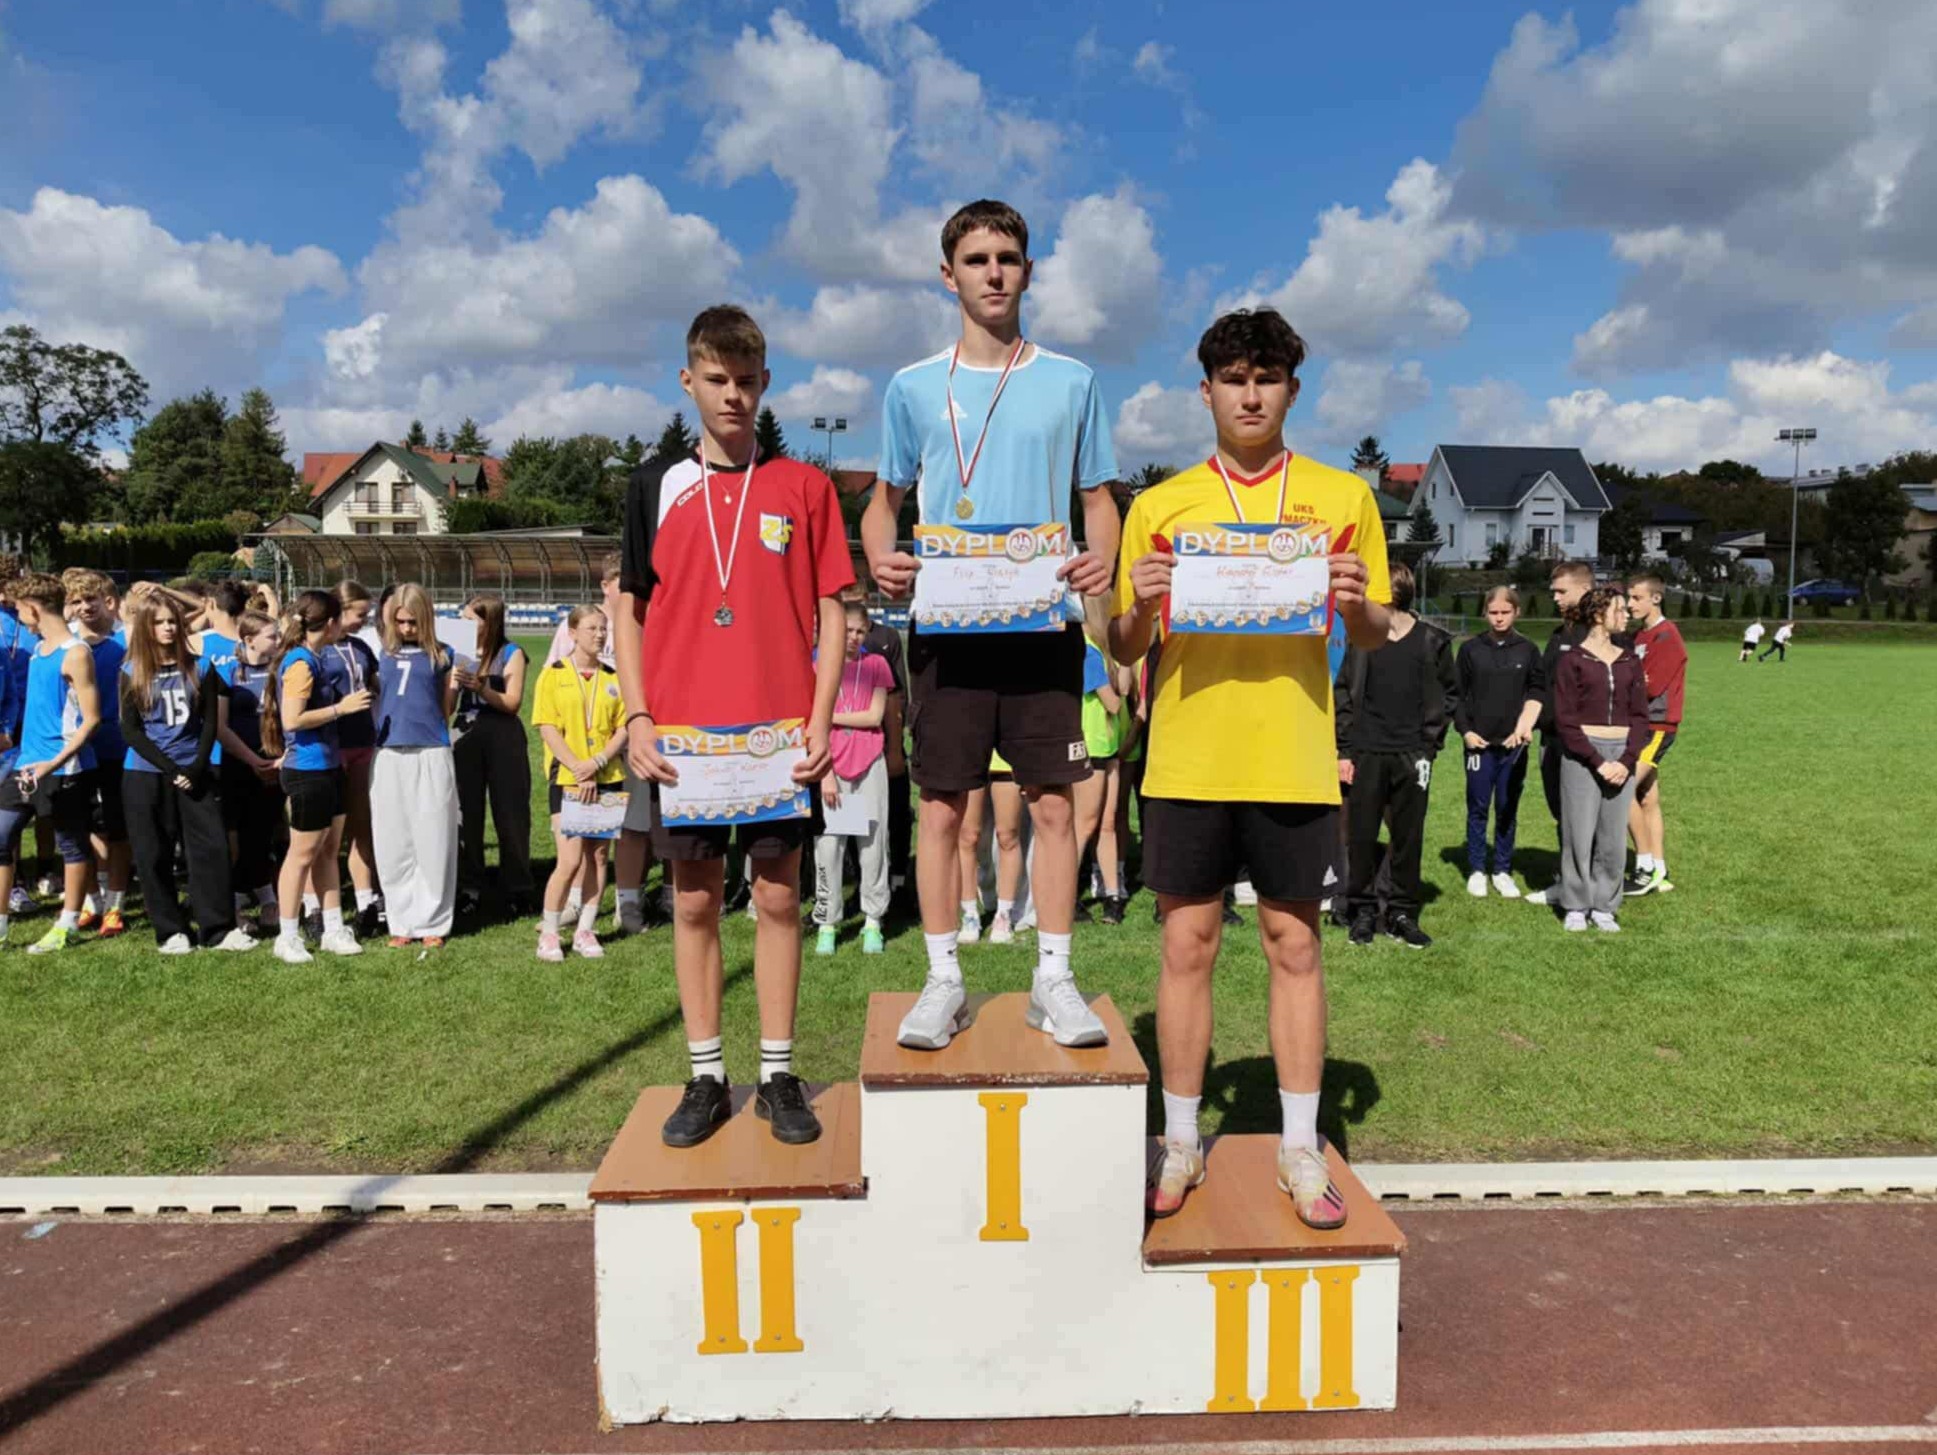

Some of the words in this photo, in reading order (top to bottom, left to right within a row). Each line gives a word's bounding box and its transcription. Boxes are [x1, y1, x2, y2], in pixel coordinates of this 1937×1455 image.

[920, 527, 1063, 562] DYPLOM
[1180, 527, 1329, 562] DYPLOM
[396, 660, 412, 696] 7
[161, 688, 190, 727] 15
[663, 725, 803, 757] DYPLOM
[977, 1091, 1030, 1242] I
[691, 1207, 805, 1355] II
[1206, 1265, 1361, 1414] III
